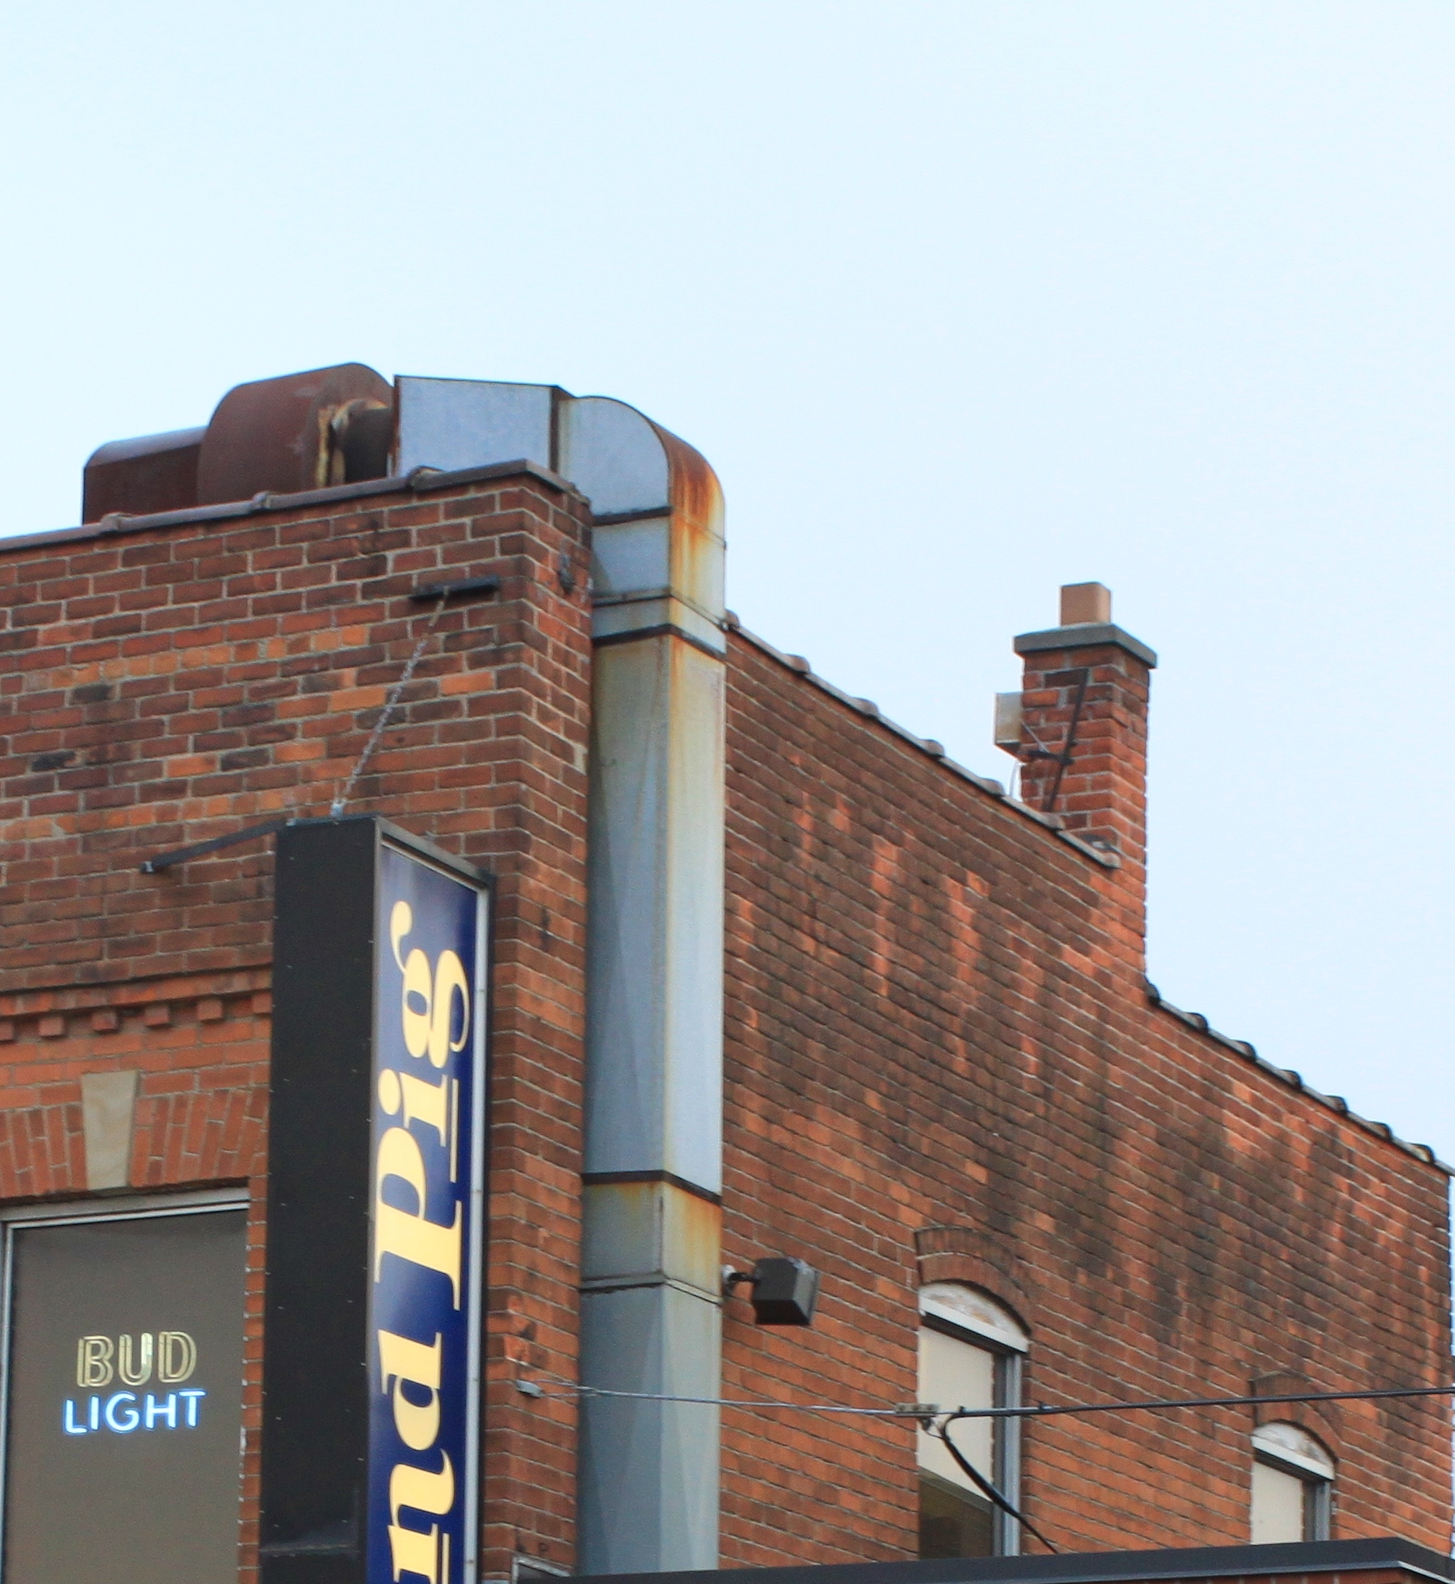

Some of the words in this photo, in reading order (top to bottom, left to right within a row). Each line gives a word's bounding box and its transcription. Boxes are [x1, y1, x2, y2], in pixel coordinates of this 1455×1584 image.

[373, 900, 471, 1312] Pig
[76, 1331, 198, 1388] BUD
[64, 1390, 208, 1435] LIGHT
